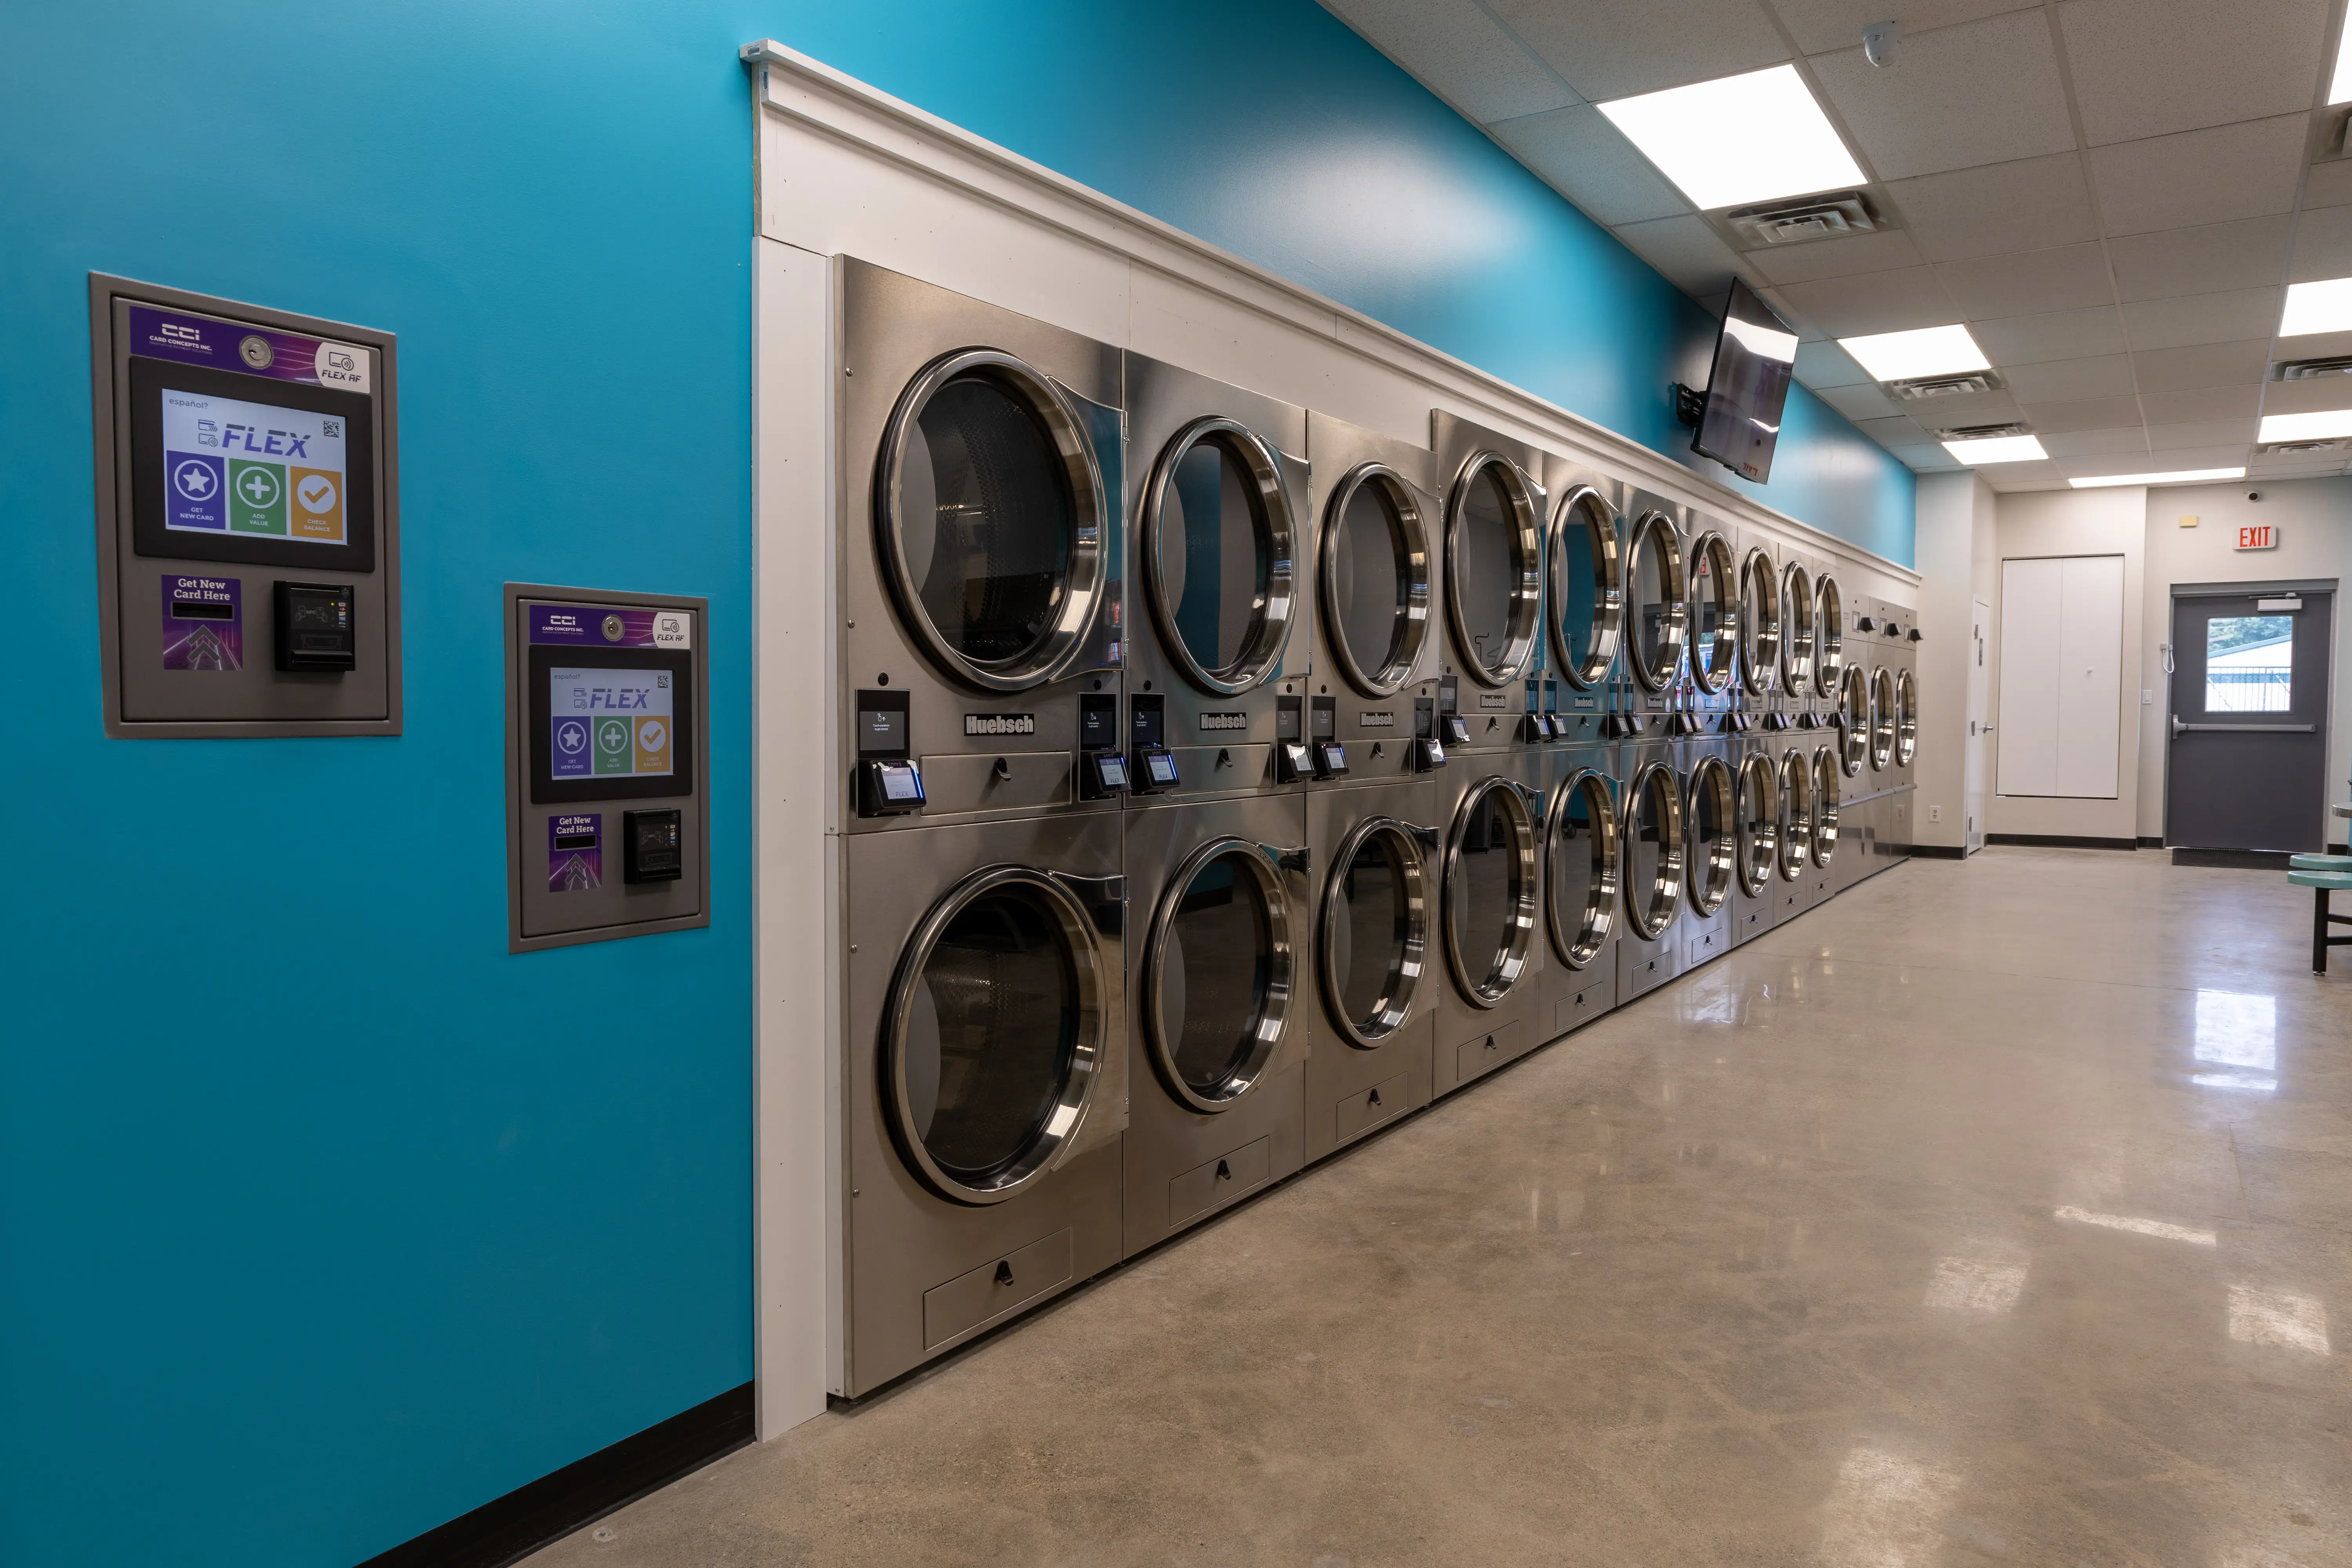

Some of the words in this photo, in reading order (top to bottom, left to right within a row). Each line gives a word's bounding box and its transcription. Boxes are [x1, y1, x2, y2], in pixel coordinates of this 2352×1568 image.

[168, 339, 199, 348] CONCEPTS
[321, 369, 347, 381] FLEX
[169, 398, 209, 409] español?
[222, 423, 311, 459] FLEX
[2239, 526, 2271, 547] EXIT
[178, 578, 197, 588] Get
[200, 580, 225, 589] New
[174, 589, 201, 599] Card
[203, 591, 230, 601] Here
[590, 688, 650, 709] FLEX
[966, 715, 1034, 733] Huebsch
[1201, 714, 1246, 729] Huebsch
[1361, 713, 1393, 725] Huebsch
[557, 826, 575, 834] Card
